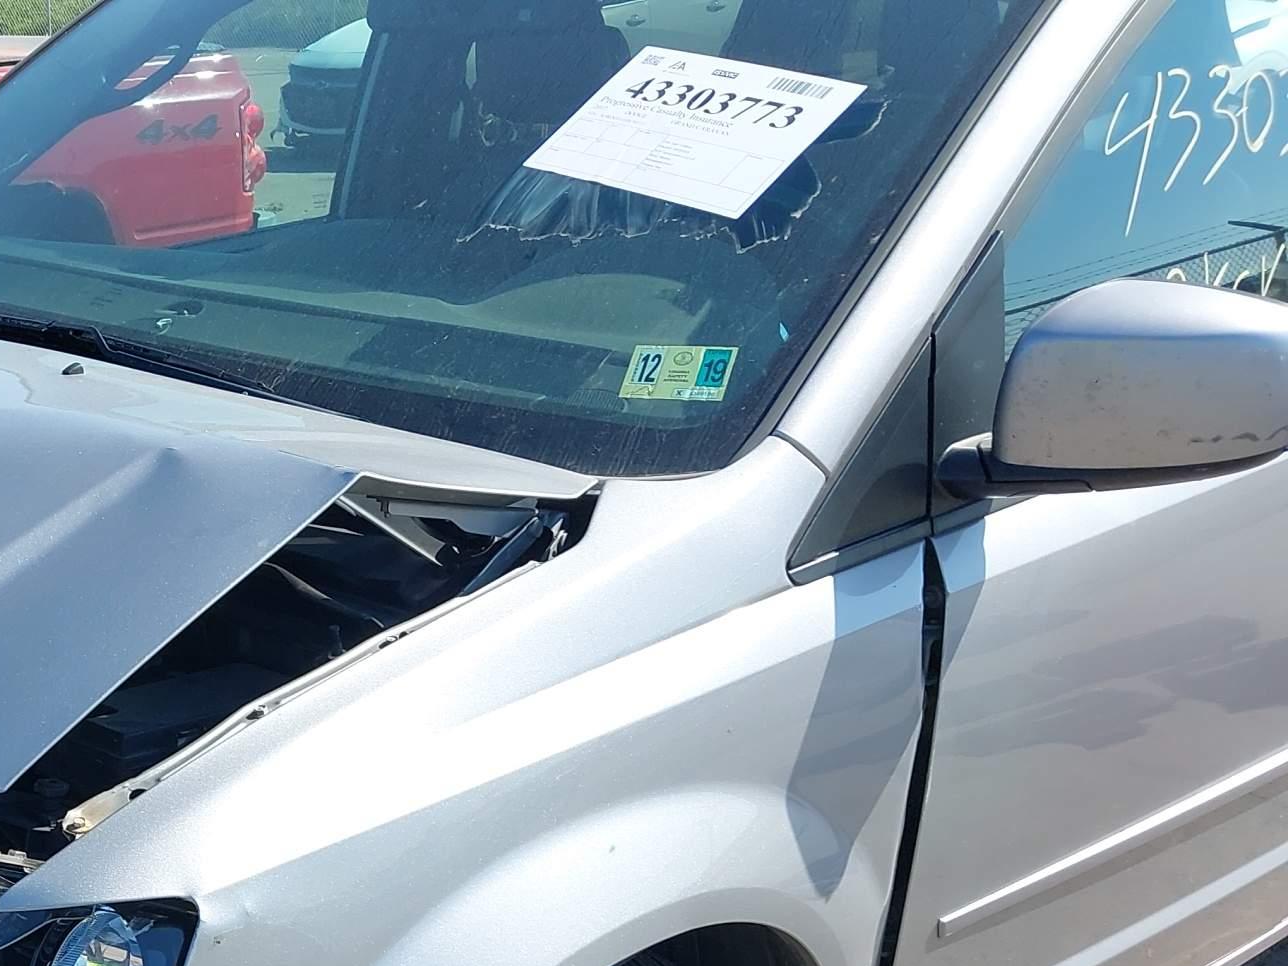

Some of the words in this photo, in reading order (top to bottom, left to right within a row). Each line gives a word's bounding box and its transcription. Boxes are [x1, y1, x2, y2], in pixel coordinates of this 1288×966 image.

[600, 95, 650, 112] Progressive
[650, 104, 686, 119] Casualty
[689, 112, 734, 129] Insurance
[625, 77, 805, 129] 43303773
[136, 114, 223, 145] 4x4
[1104, 64, 1288, 237] 4330
[638, 353, 662, 382] 12
[703, 359, 728, 383] 19
